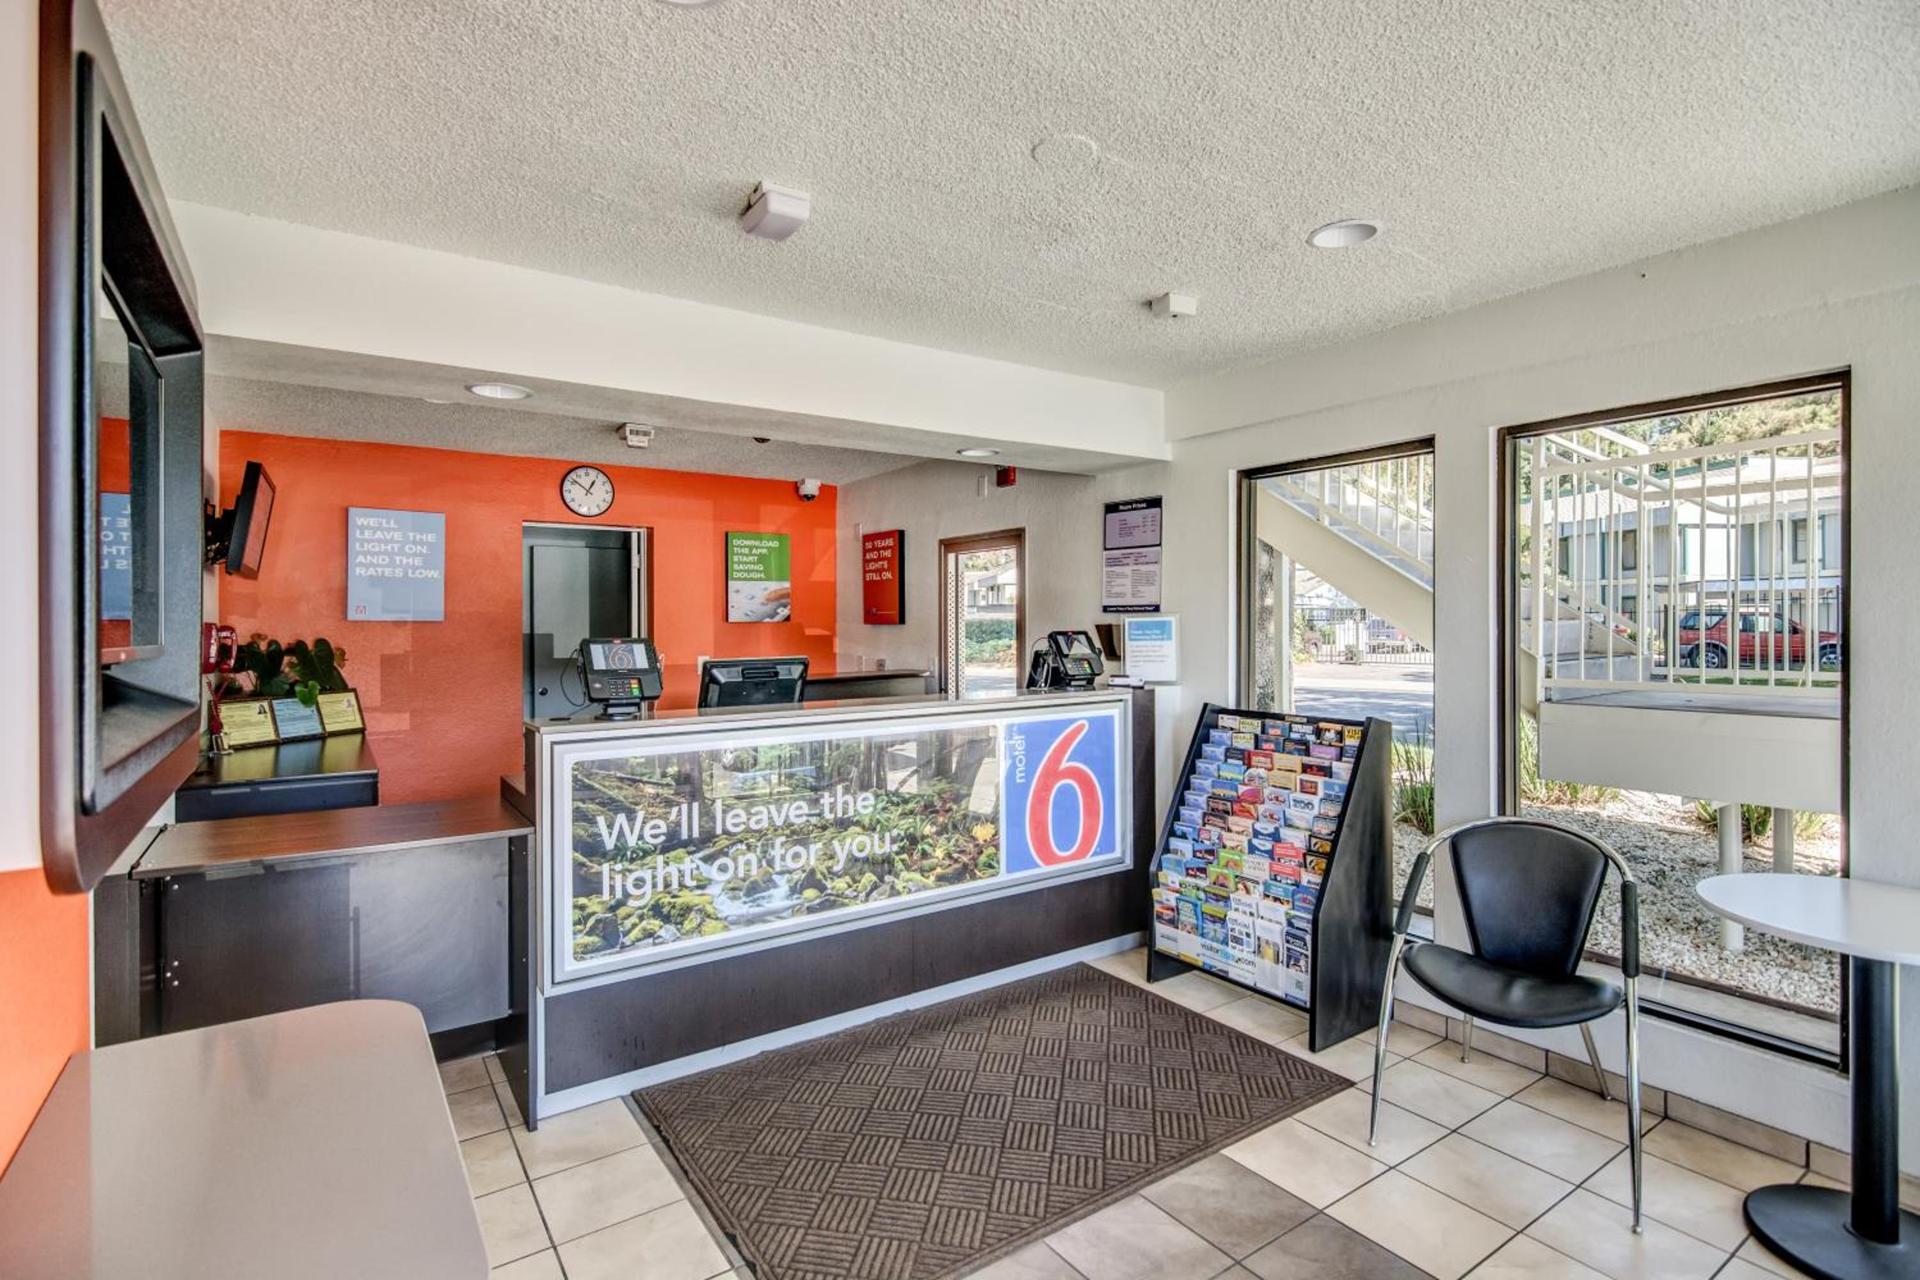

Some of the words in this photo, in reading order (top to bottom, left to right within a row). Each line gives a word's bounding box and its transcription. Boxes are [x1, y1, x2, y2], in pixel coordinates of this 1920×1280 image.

[355, 517, 399, 528] WE'LL
[355, 529, 403, 541] LEAVE
[408, 532, 437, 543] THE
[355, 541, 401, 552] LIGHT
[404, 544, 431, 554] ON.
[732, 538, 779, 548] DOWNLOAD
[874, 538, 894, 548] YEARS
[733, 547, 750, 555] THE
[866, 551, 879, 560] AND
[880, 548, 892, 558] THE
[355, 554, 389, 565] AND
[394, 556, 424, 566] THE
[733, 555, 758, 563] START
[355, 566, 403, 577] RATES
[408, 569, 441, 579] LOW.
[733, 563, 764, 571] SAVING
[733, 571, 766, 579] DOUGH.
[865, 571, 881, 581] STILL
[1013, 735, 1026, 784] motel
[1026, 719, 1104, 868] 6
[597, 803, 699, 850] We'll
[714, 799, 810, 835] leave
[820, 784, 875, 820] the
[602, 854, 697, 907] light
[711, 851, 758, 882] on
[774, 836, 823, 871] for
